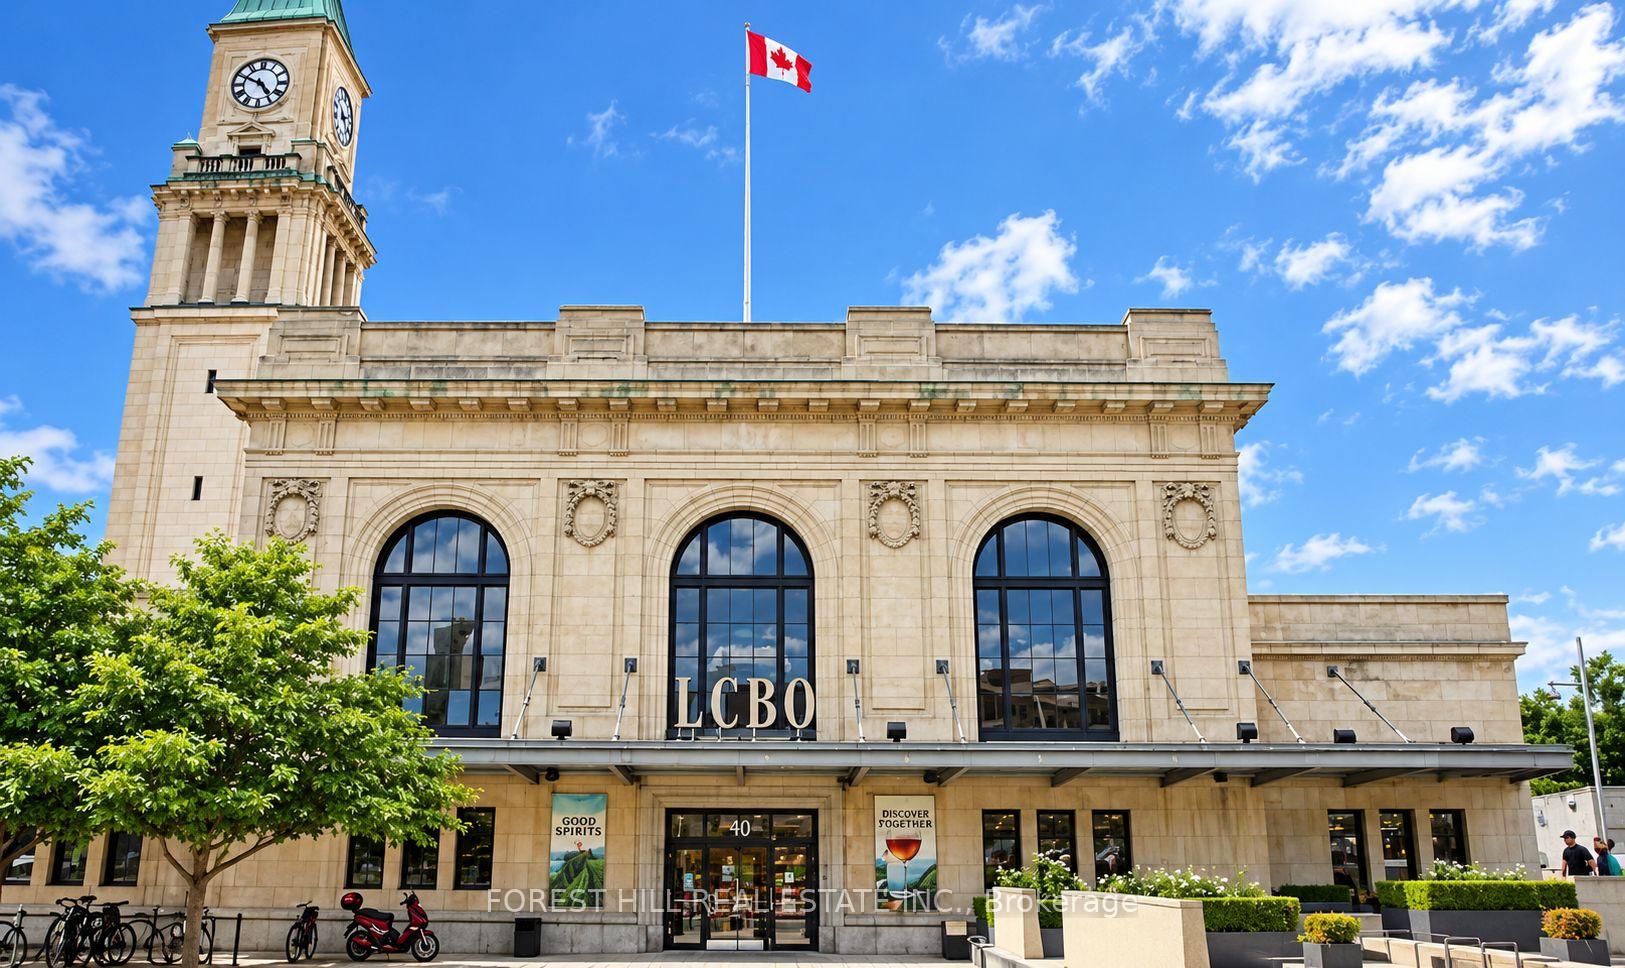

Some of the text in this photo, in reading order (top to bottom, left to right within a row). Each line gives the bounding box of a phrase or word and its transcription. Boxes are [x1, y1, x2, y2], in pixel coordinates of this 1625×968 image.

[674, 677, 815, 729] LCBO
[882, 809, 929, 819] DISCOVER
[562, 816, 596, 826] GOOD
[555, 826, 602, 836] SPIRITS
[729, 820, 751, 837] 40
